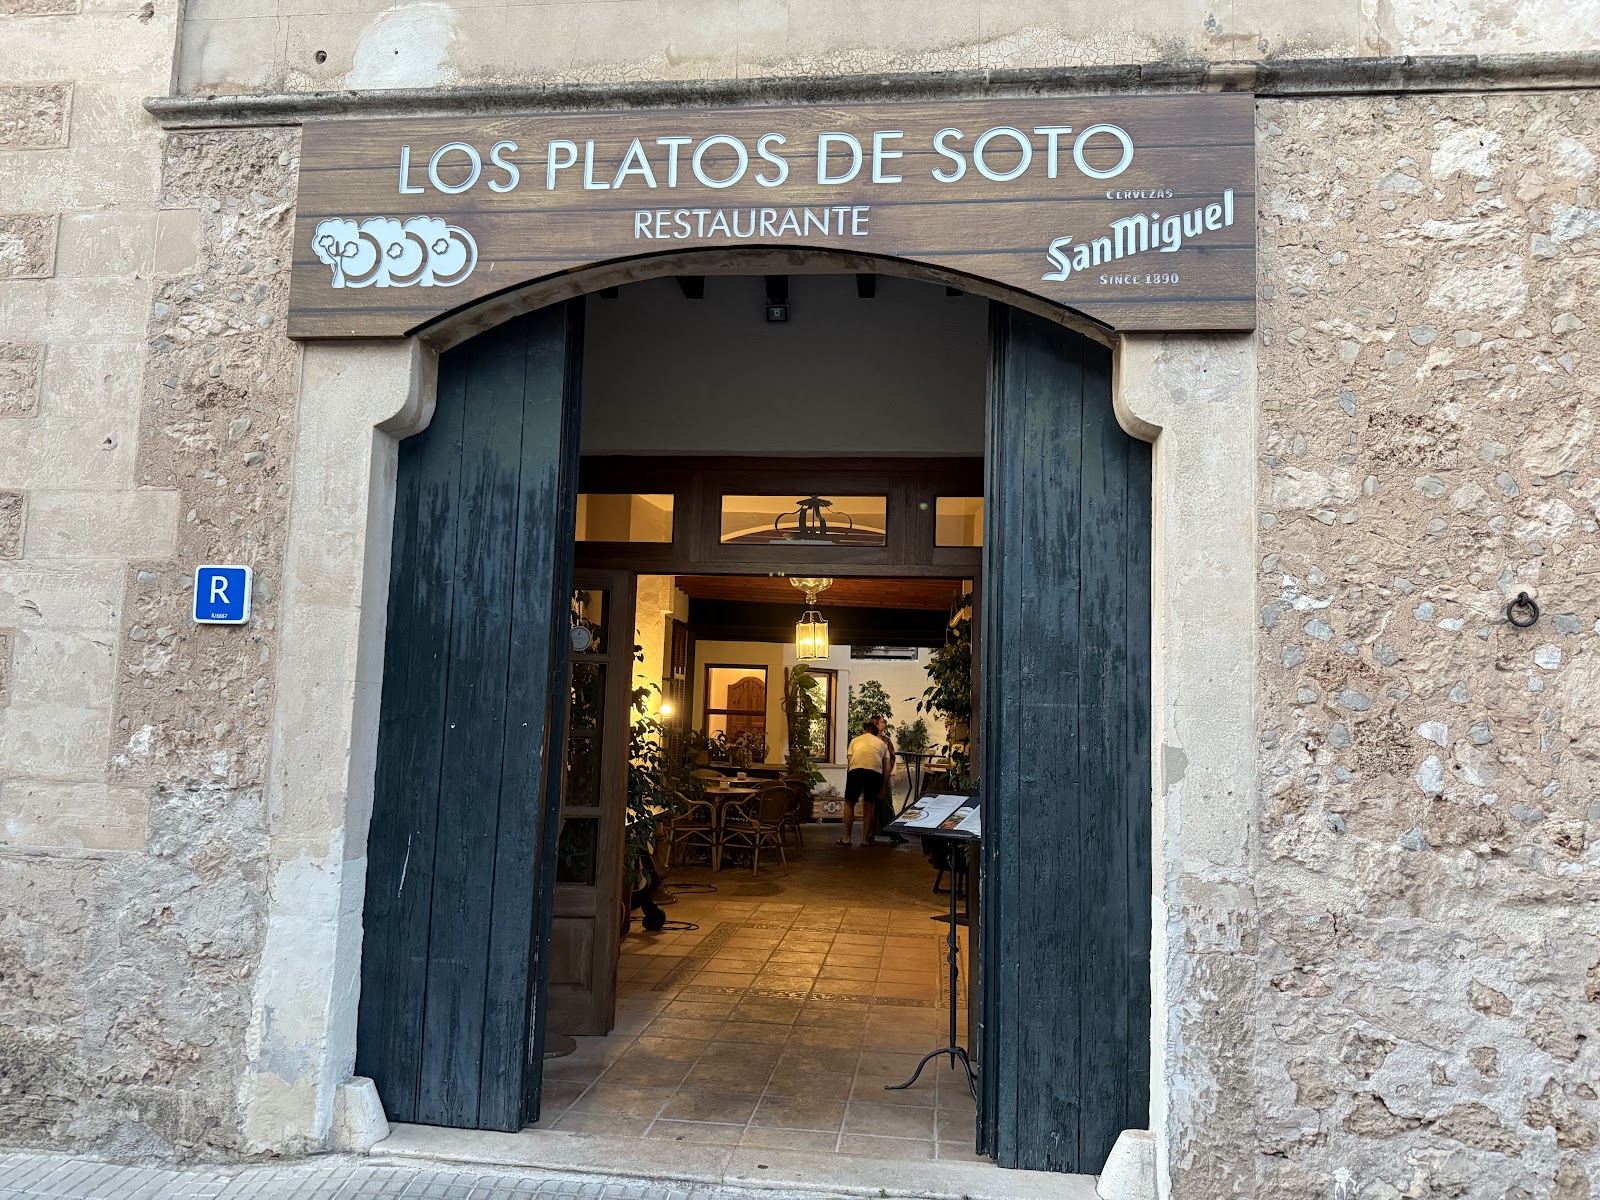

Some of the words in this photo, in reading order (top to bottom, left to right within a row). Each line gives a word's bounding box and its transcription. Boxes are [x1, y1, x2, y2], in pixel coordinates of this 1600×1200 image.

[398, 141, 520, 194] LOS
[547, 133, 789, 191] PLATOS
[817, 130, 904, 184] DE
[932, 123, 1134, 183] SOTO
[1106, 188, 1173, 200] CERVEZAS
[634, 205, 870, 239] RESTAURANTE
[1144, 273, 1180, 285] 1890
[210, 575, 230, 604] R
